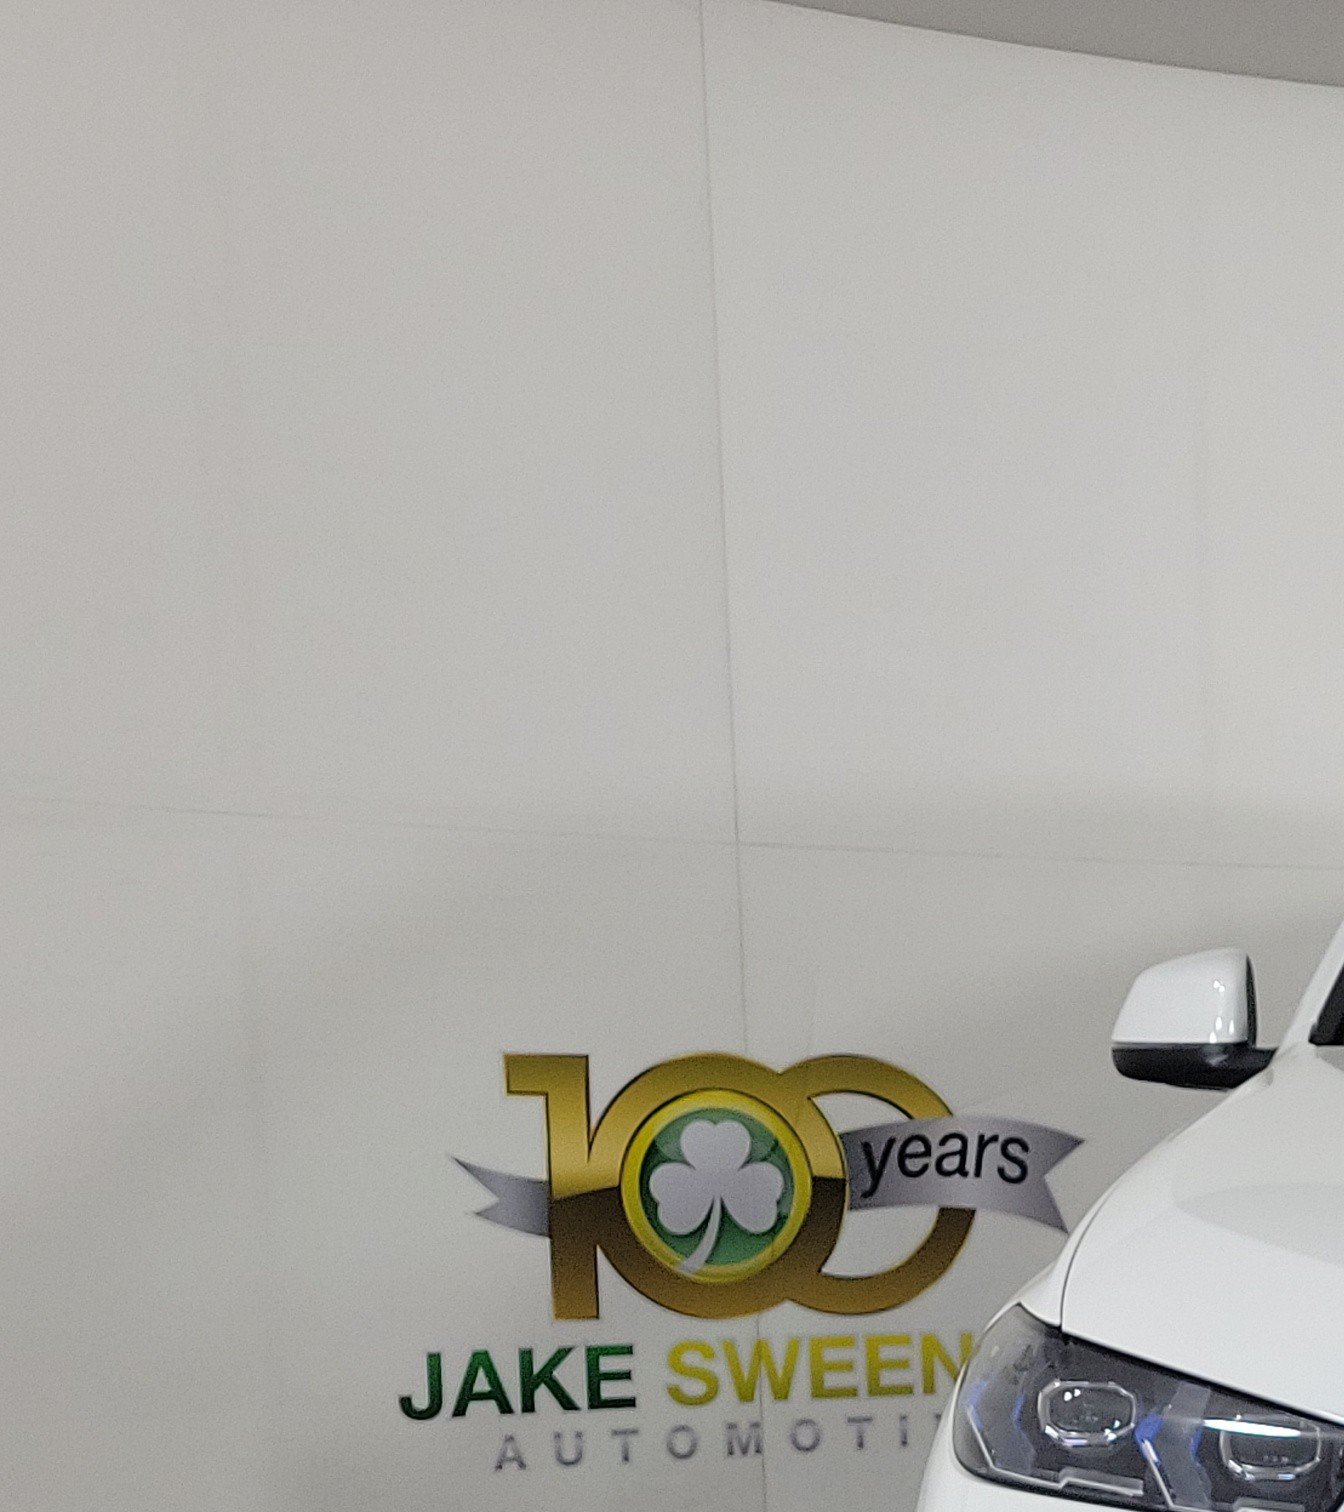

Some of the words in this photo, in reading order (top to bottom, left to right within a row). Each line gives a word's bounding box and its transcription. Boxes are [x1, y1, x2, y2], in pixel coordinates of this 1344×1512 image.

[502, 1052, 976, 1321] 100
[860, 1129, 1032, 1199] years
[398, 1344, 638, 1421] JAKE
[665, 1331, 974, 1407] SWEEN
[493, 1413, 942, 1472] AUTOMOTI
